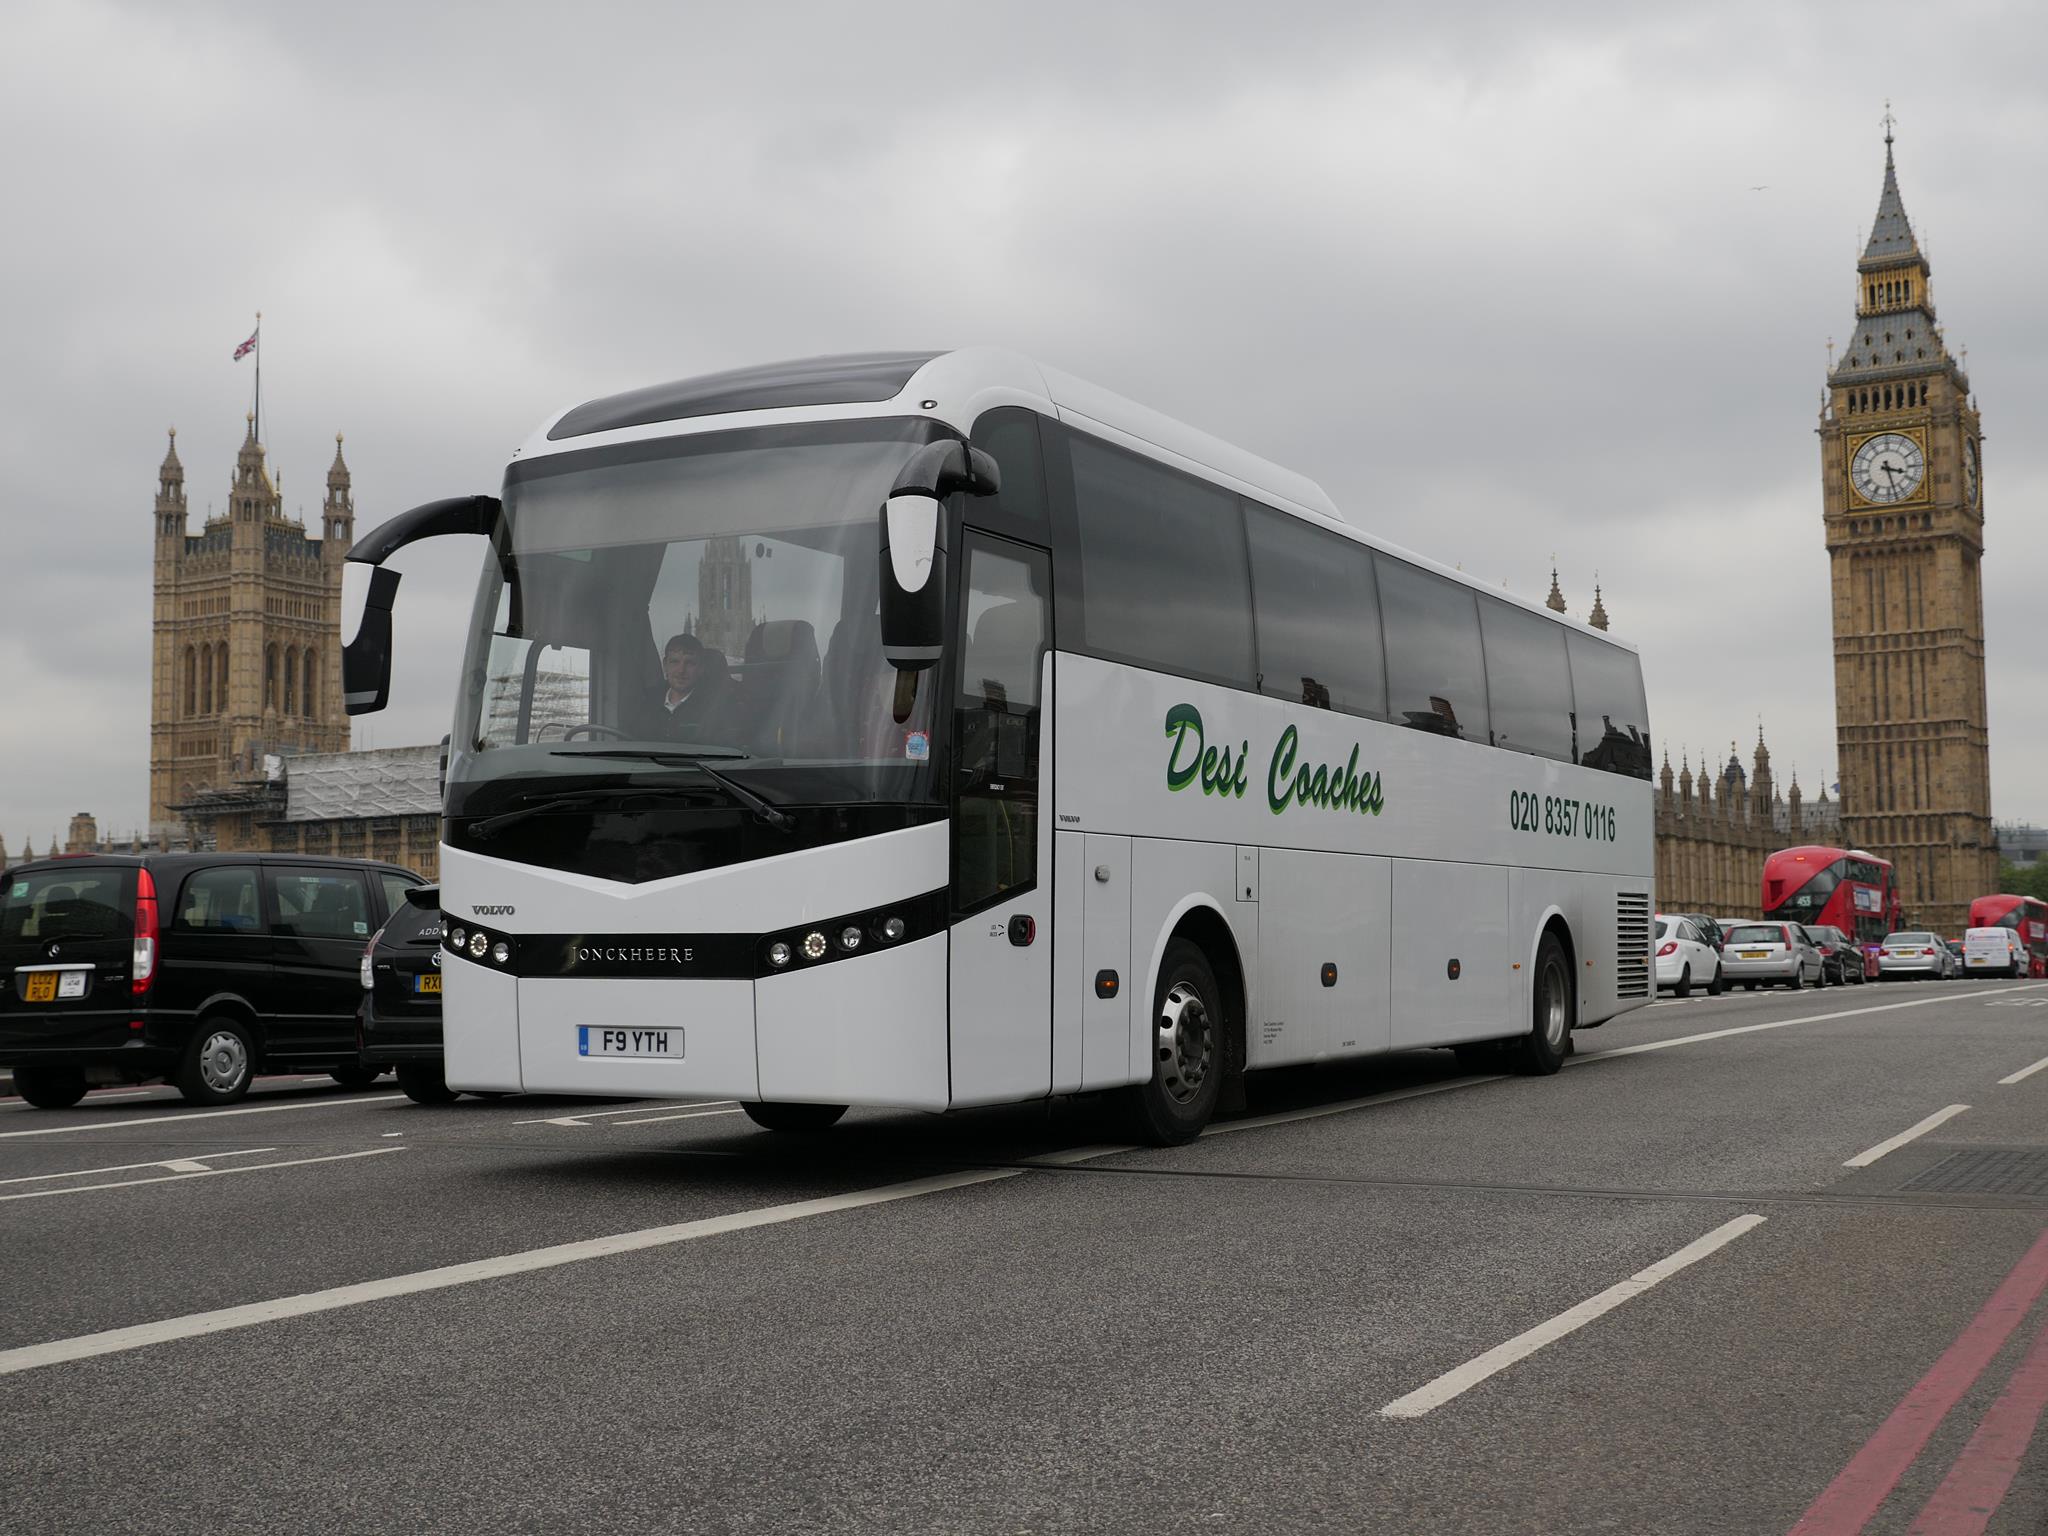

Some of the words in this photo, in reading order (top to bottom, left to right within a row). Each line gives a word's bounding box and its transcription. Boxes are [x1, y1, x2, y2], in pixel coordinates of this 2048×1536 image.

[1165, 703, 1248, 799] Desi
[1267, 724, 1385, 817] Coaches
[1511, 790, 1539, 832] 020
[1545, 795, 1580, 837] 8357
[1584, 802, 1616, 842] 0116
[472, 905, 515, 915] VOLVO
[1797, 895, 1811, 907] 453
[603, 1030, 627, 1052] F9
[632, 1031, 668, 1053] YTH
